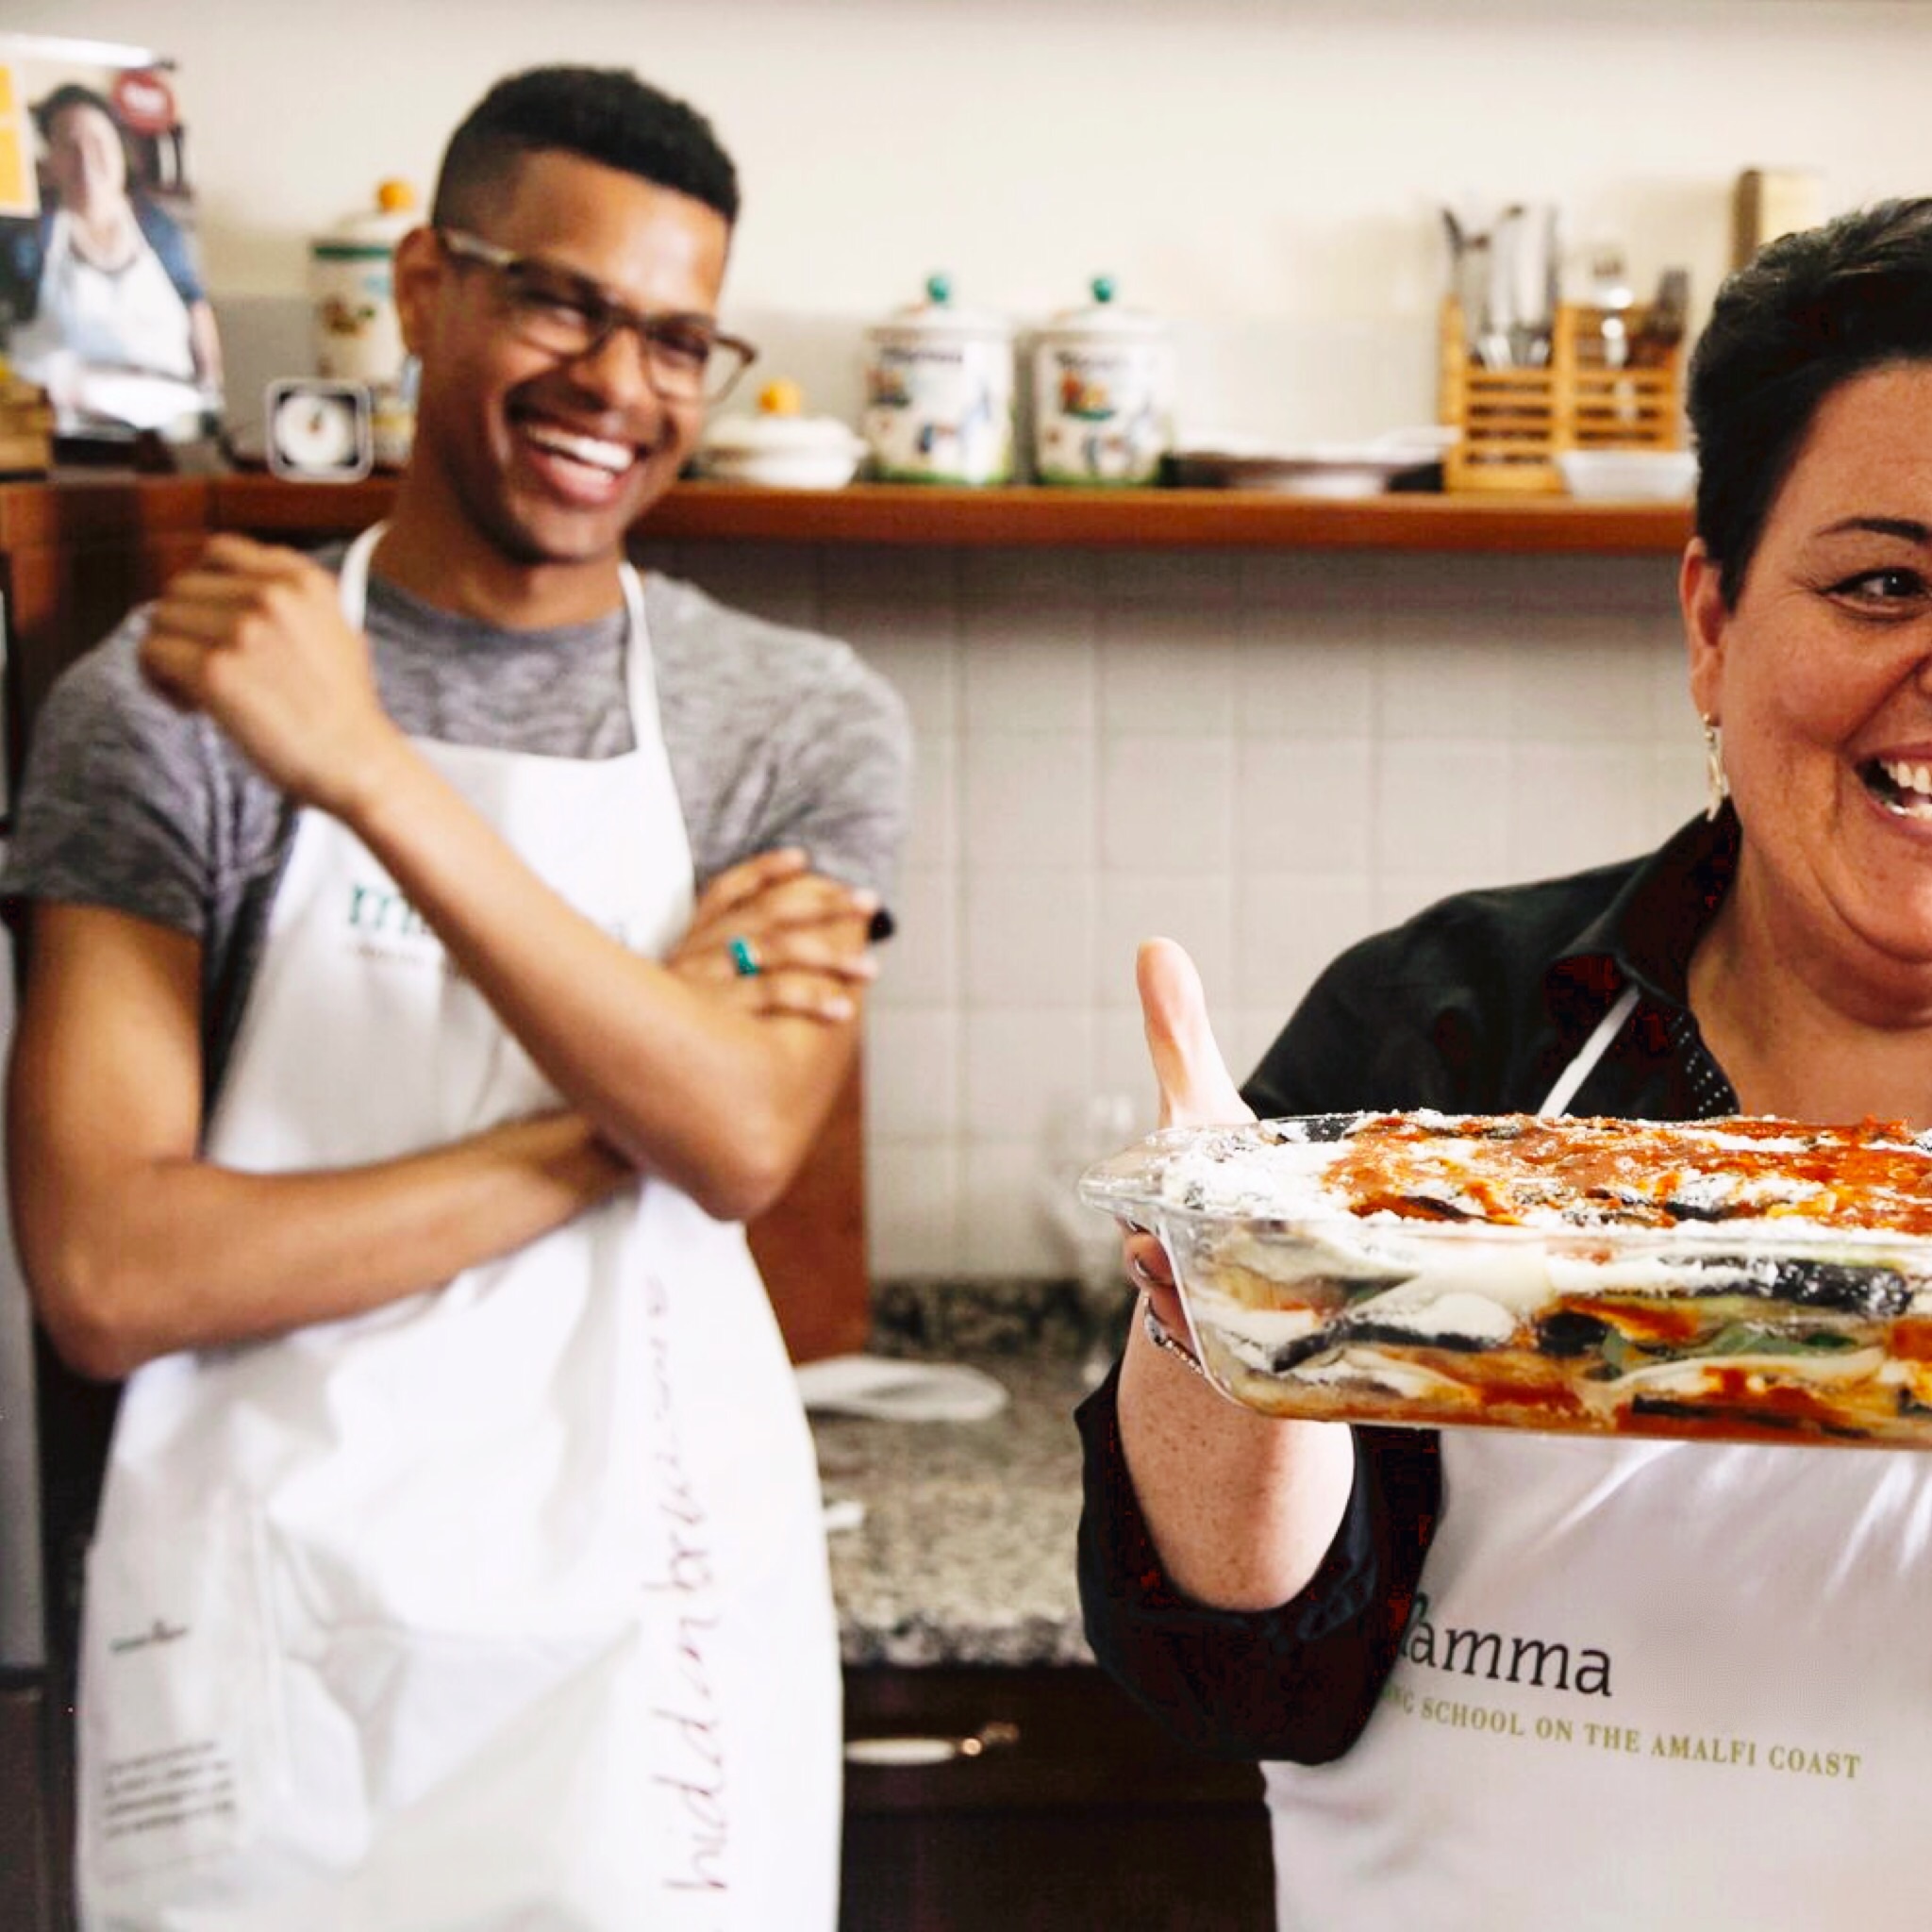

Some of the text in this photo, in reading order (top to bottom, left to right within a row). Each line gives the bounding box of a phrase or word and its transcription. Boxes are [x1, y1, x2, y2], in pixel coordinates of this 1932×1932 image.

[1421, 1697, 1524, 1737] SCHOOL
[1535, 1716, 1574, 1742] ON
[1583, 1723, 1641, 1753] THE
[1651, 1733, 1757, 1767] AMALFI
[1768, 1745, 1862, 1779] COAST
